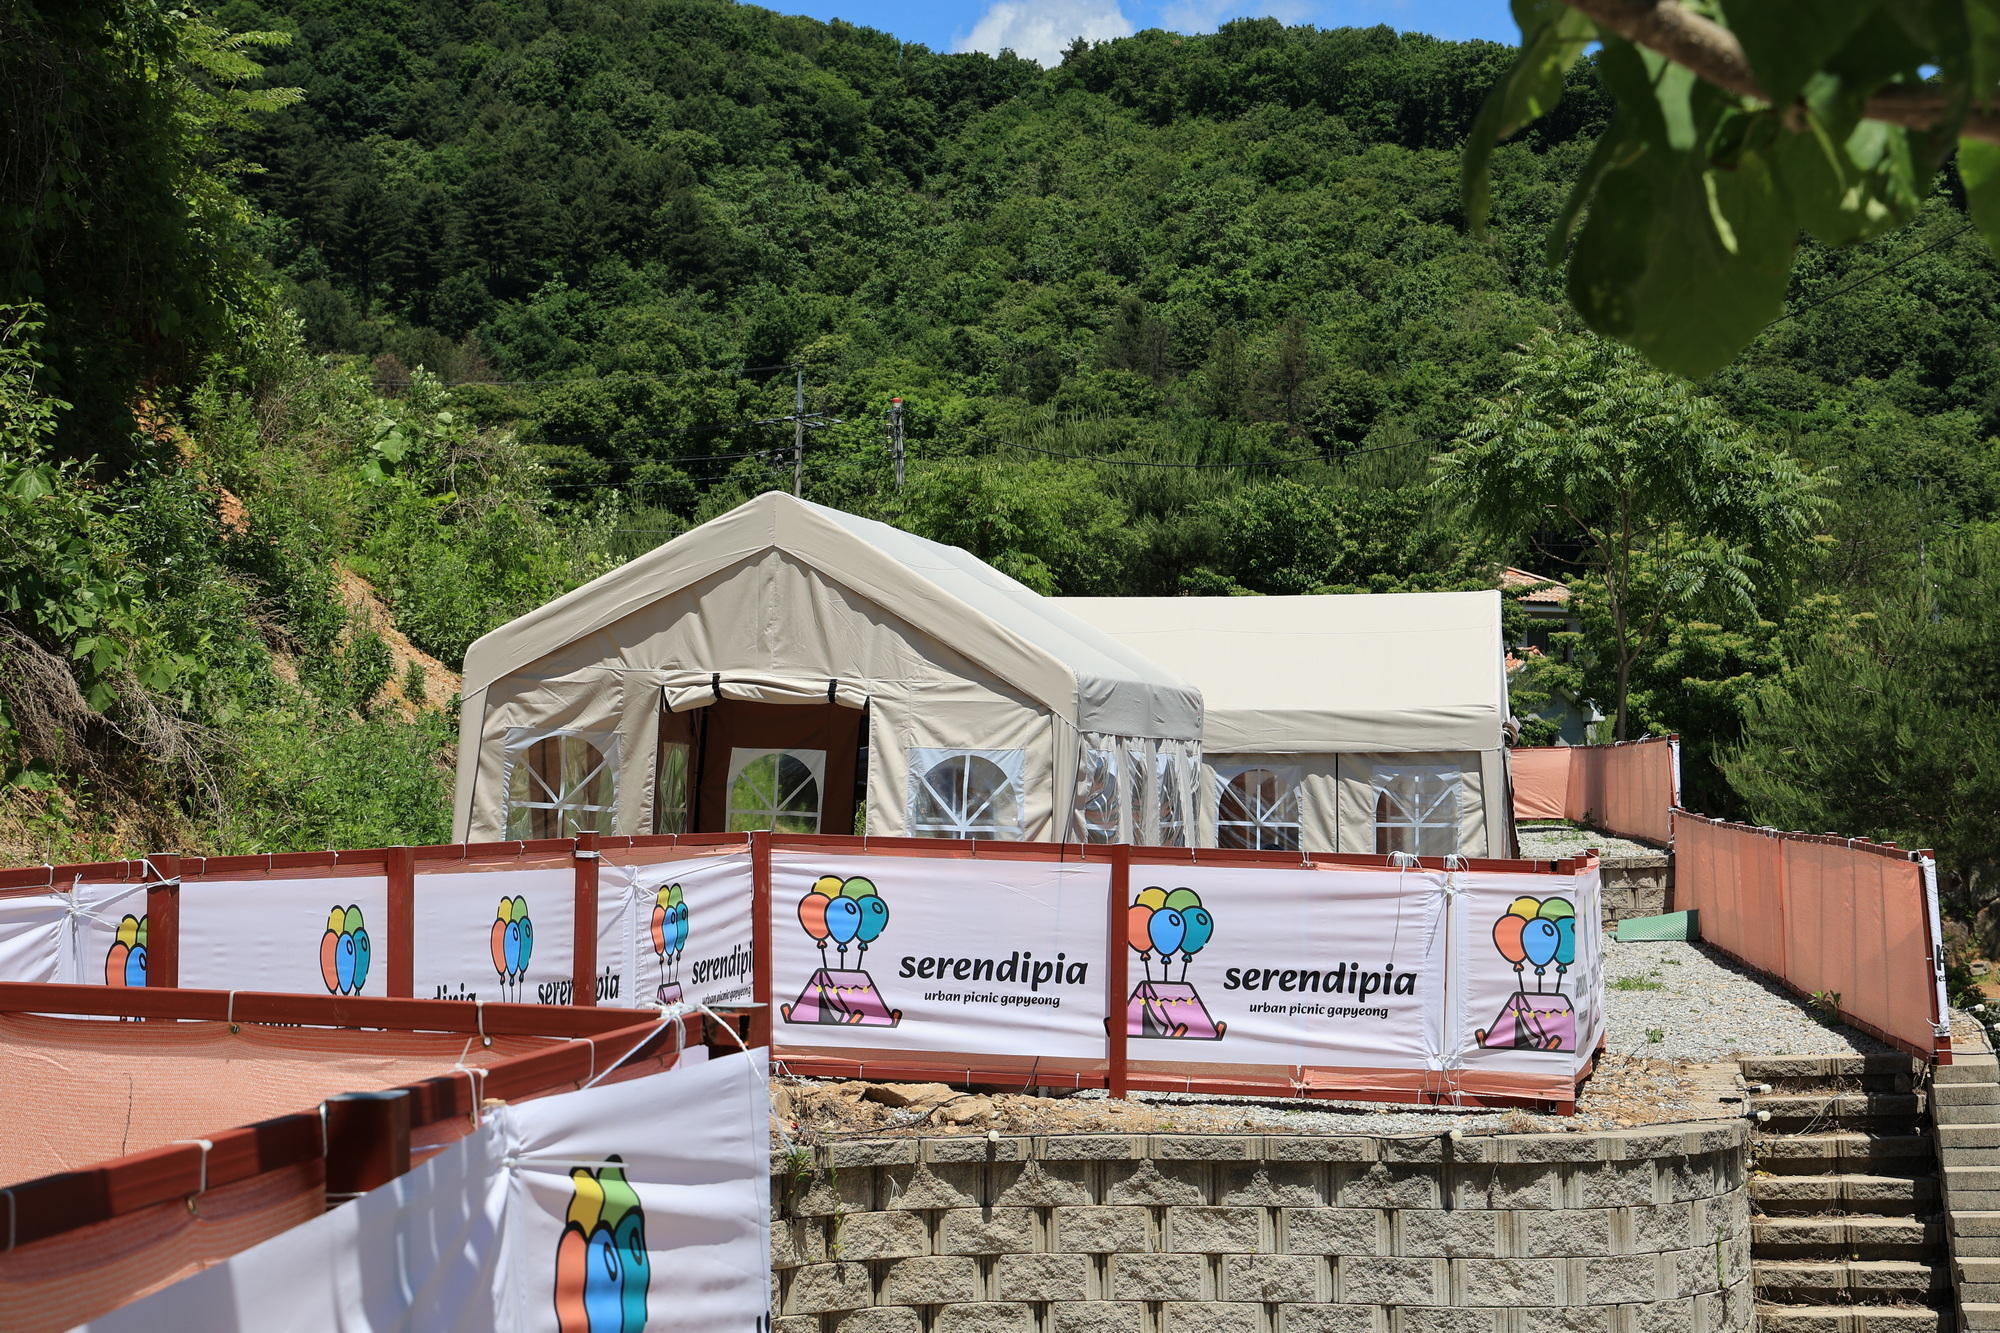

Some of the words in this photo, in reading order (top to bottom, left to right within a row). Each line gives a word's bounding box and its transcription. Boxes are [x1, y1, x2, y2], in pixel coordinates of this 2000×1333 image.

[692, 941, 754, 985] serendipi
[898, 951, 1089, 992] serendipia
[1223, 962, 1417, 1003] serendipia
[924, 990, 961, 1002] urban
[963, 991, 999, 1005] picnic
[1000, 995, 1061, 1008] gapyeong
[1249, 1002, 1286, 1014] urban
[1289, 1003, 1326, 1016] picnic
[1327, 1006, 1389, 1019] gapyeong
